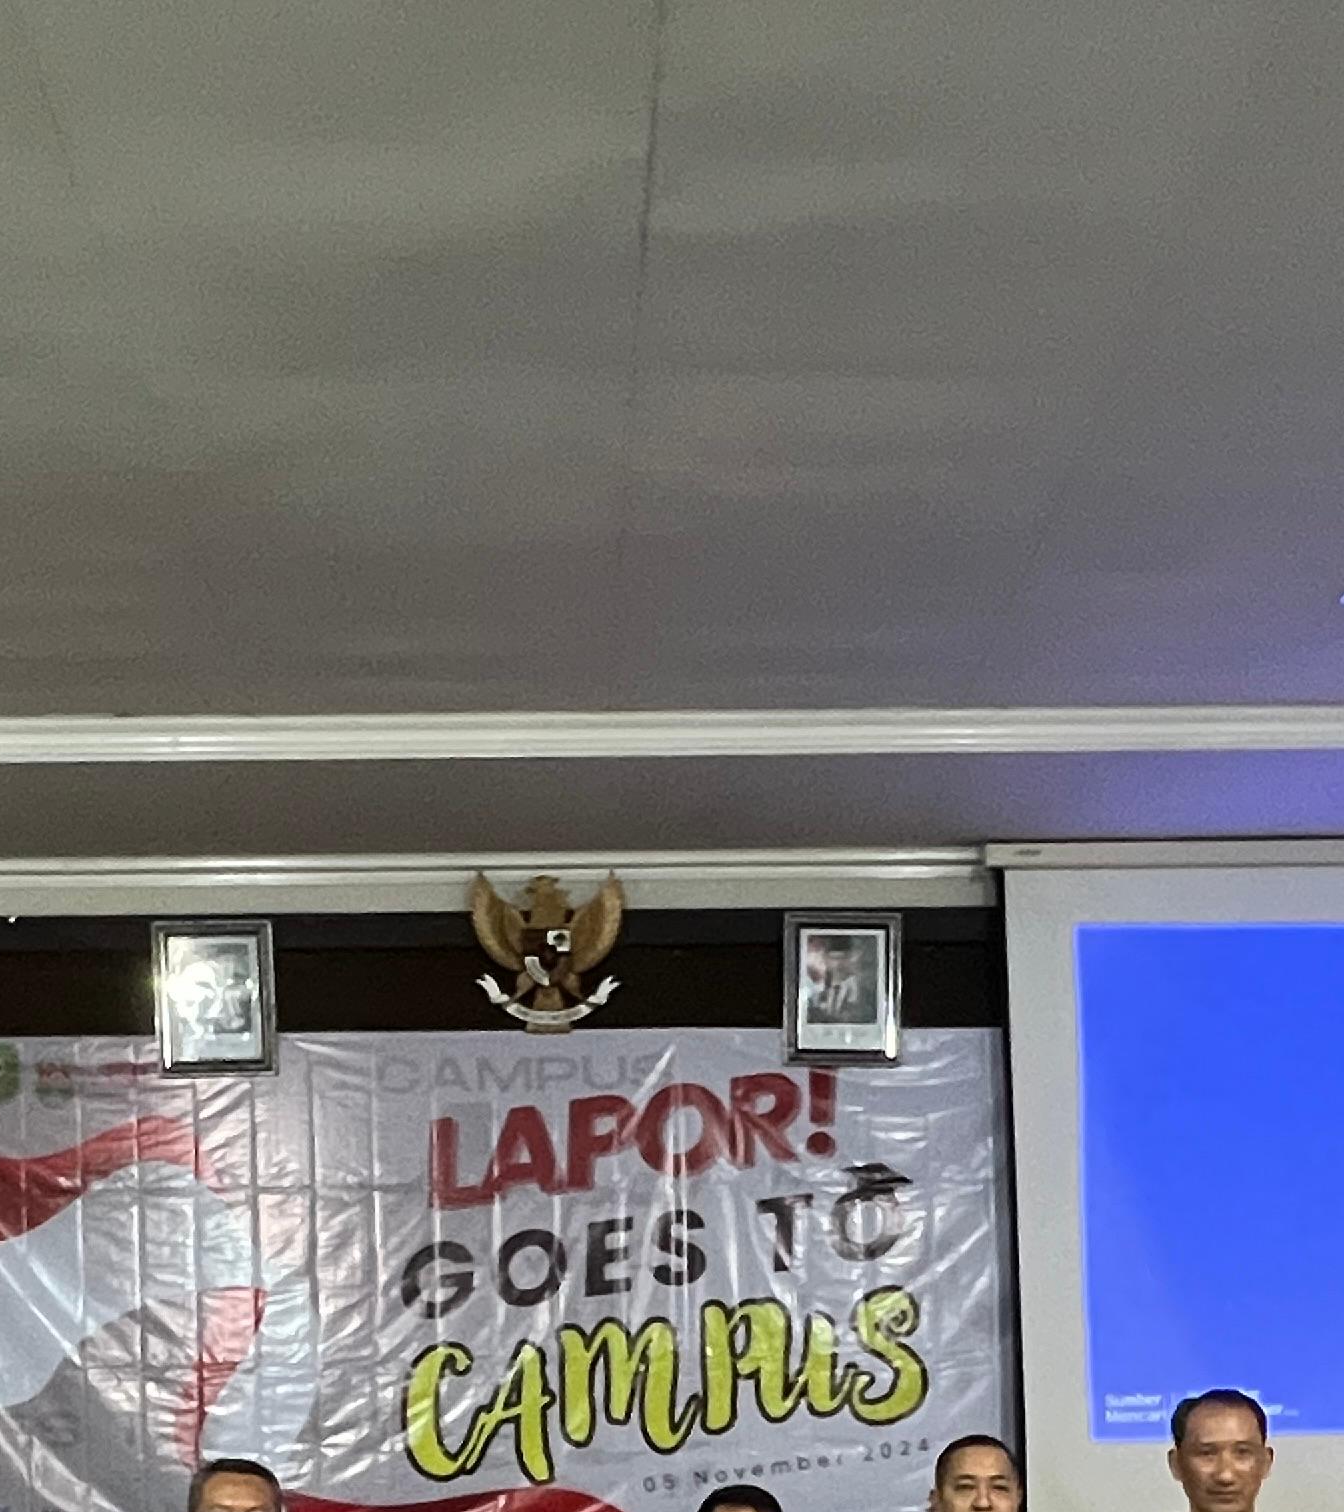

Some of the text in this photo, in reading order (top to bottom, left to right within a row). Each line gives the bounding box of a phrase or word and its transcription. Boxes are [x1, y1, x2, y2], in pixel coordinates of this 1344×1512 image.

[428, 1066, 839, 1210] LAPOR!
[401, 1209, 707, 1319] GOES
[757, 1190, 904, 1273] TO
[405, 1284, 930, 1484] CAMPUS
[642, 1438, 929, 1493] 05 November 2024
